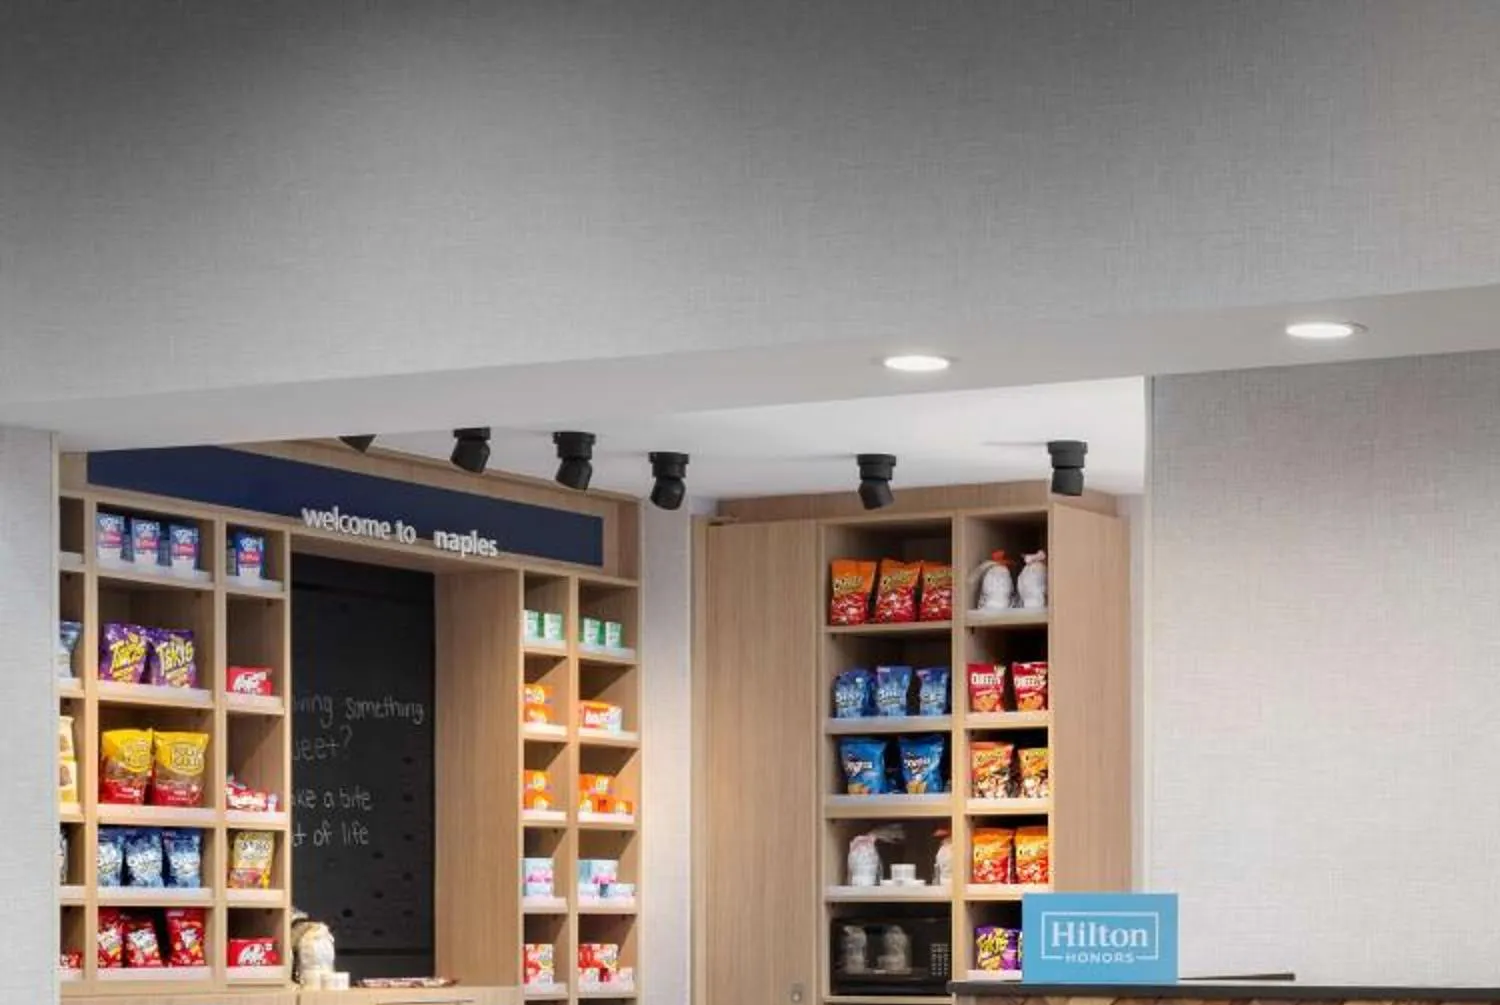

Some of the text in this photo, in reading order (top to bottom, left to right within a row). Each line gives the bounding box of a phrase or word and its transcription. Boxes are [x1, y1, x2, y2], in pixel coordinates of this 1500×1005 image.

[301, 505, 498, 558] welcome to naples
[345, 694, 424, 725] something
[322, 790, 335, 809] a
[313, 819, 333, 847] of
[340, 819, 370, 846] life
[1051, 920, 1149, 949] Hilton
[1064, 951, 1136, 965] HONORS
